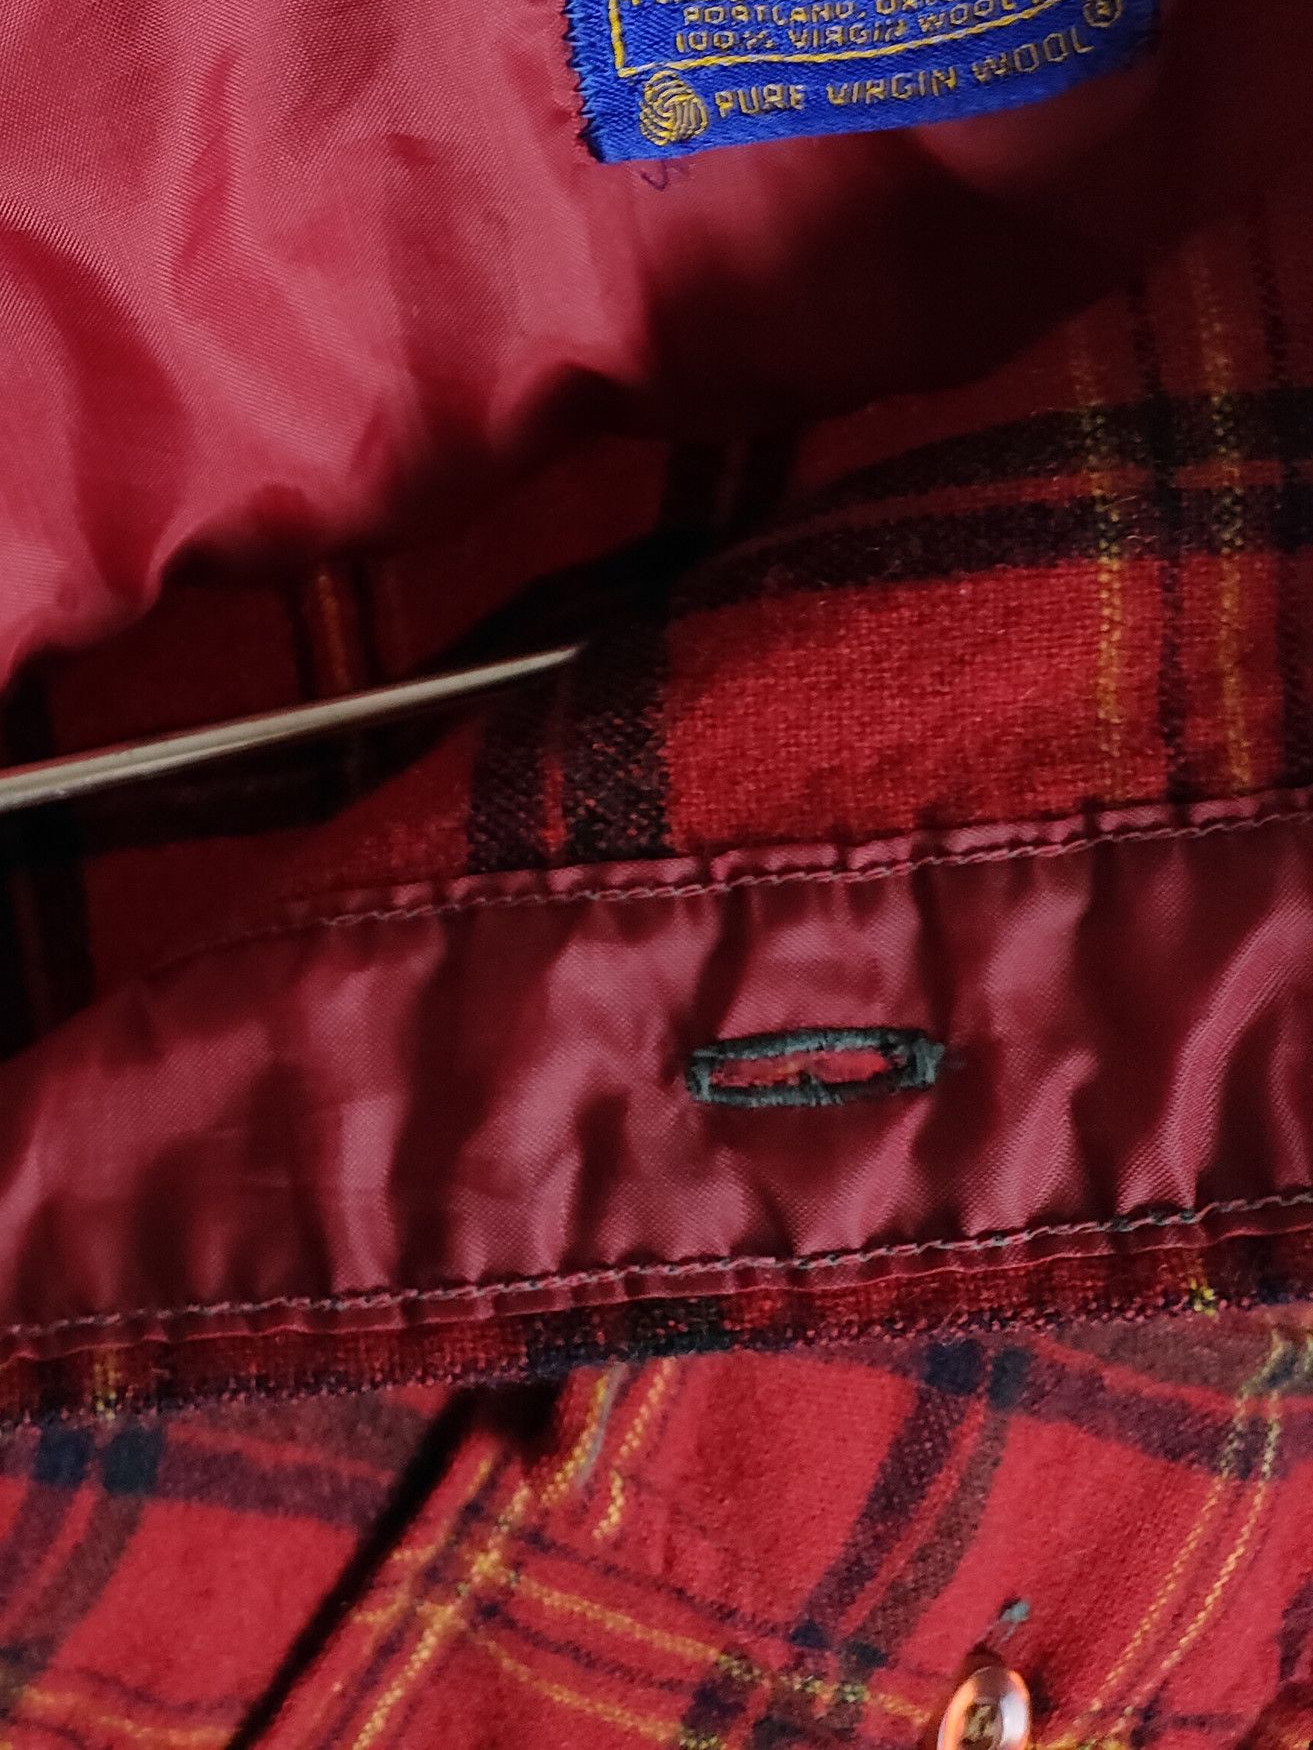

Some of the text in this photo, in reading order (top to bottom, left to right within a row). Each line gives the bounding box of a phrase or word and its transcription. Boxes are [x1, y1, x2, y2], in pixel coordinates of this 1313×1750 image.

[683, 1, 867, 27] PORTLAND,
[787, 16, 908, 49] VIRGIN
[714, 83, 807, 119] PURE
[826, 65, 958, 106] VIRGIN
[970, 25, 1095, 84] WOOL
